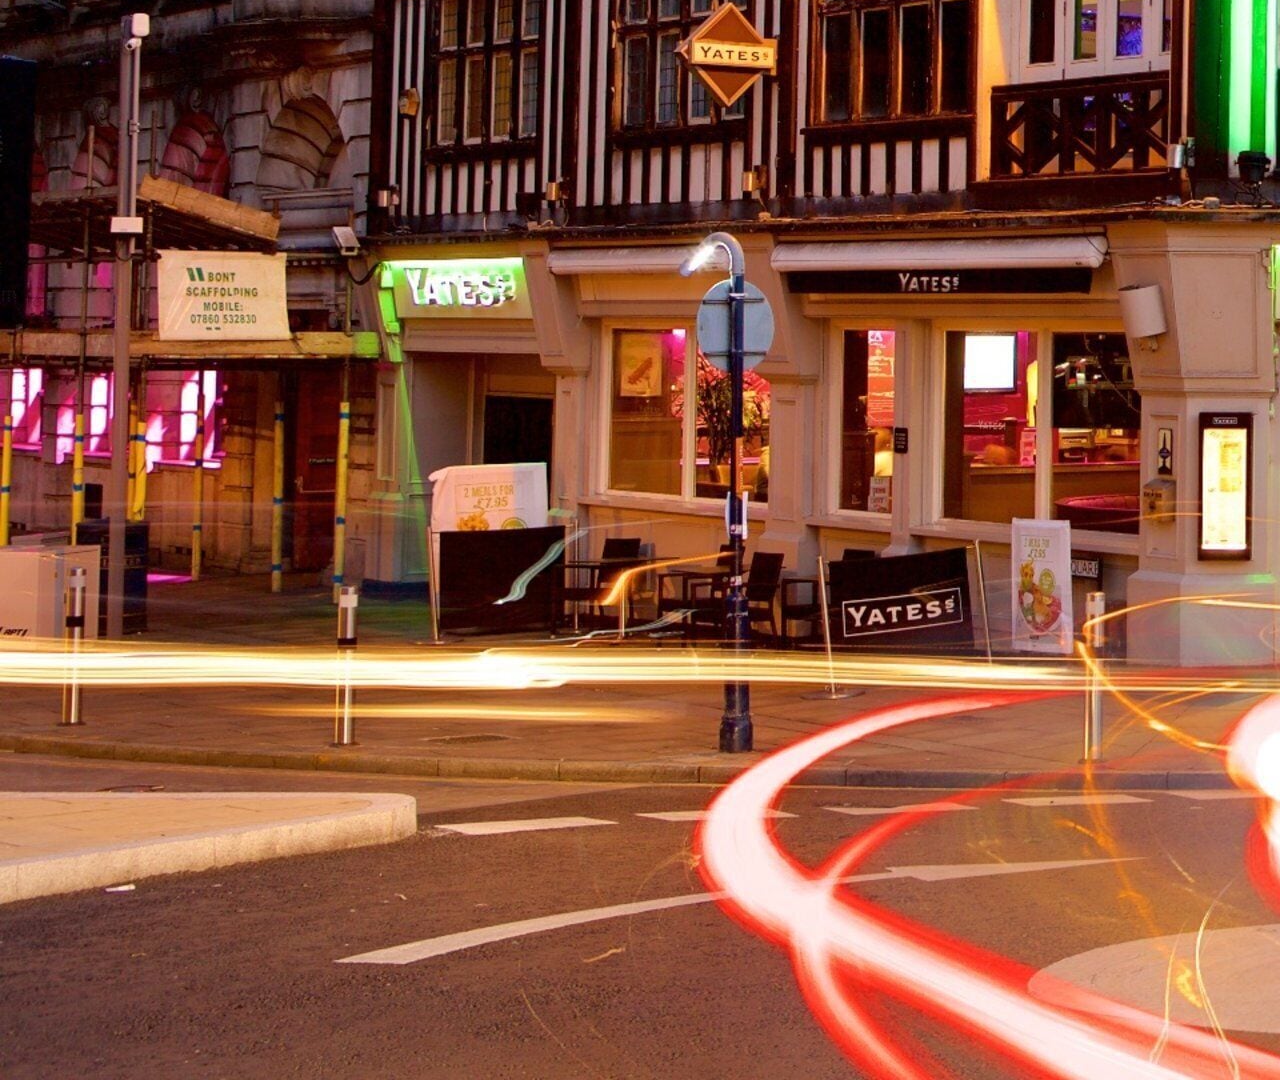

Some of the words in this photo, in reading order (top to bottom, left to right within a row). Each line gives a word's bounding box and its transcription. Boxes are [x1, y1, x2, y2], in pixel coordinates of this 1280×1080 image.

[207, 272, 236, 282] BONT
[186, 287, 258, 297] SCAFFOLDING
[203, 302, 244, 311] MOBILE:
[463, 487, 469, 498] 2
